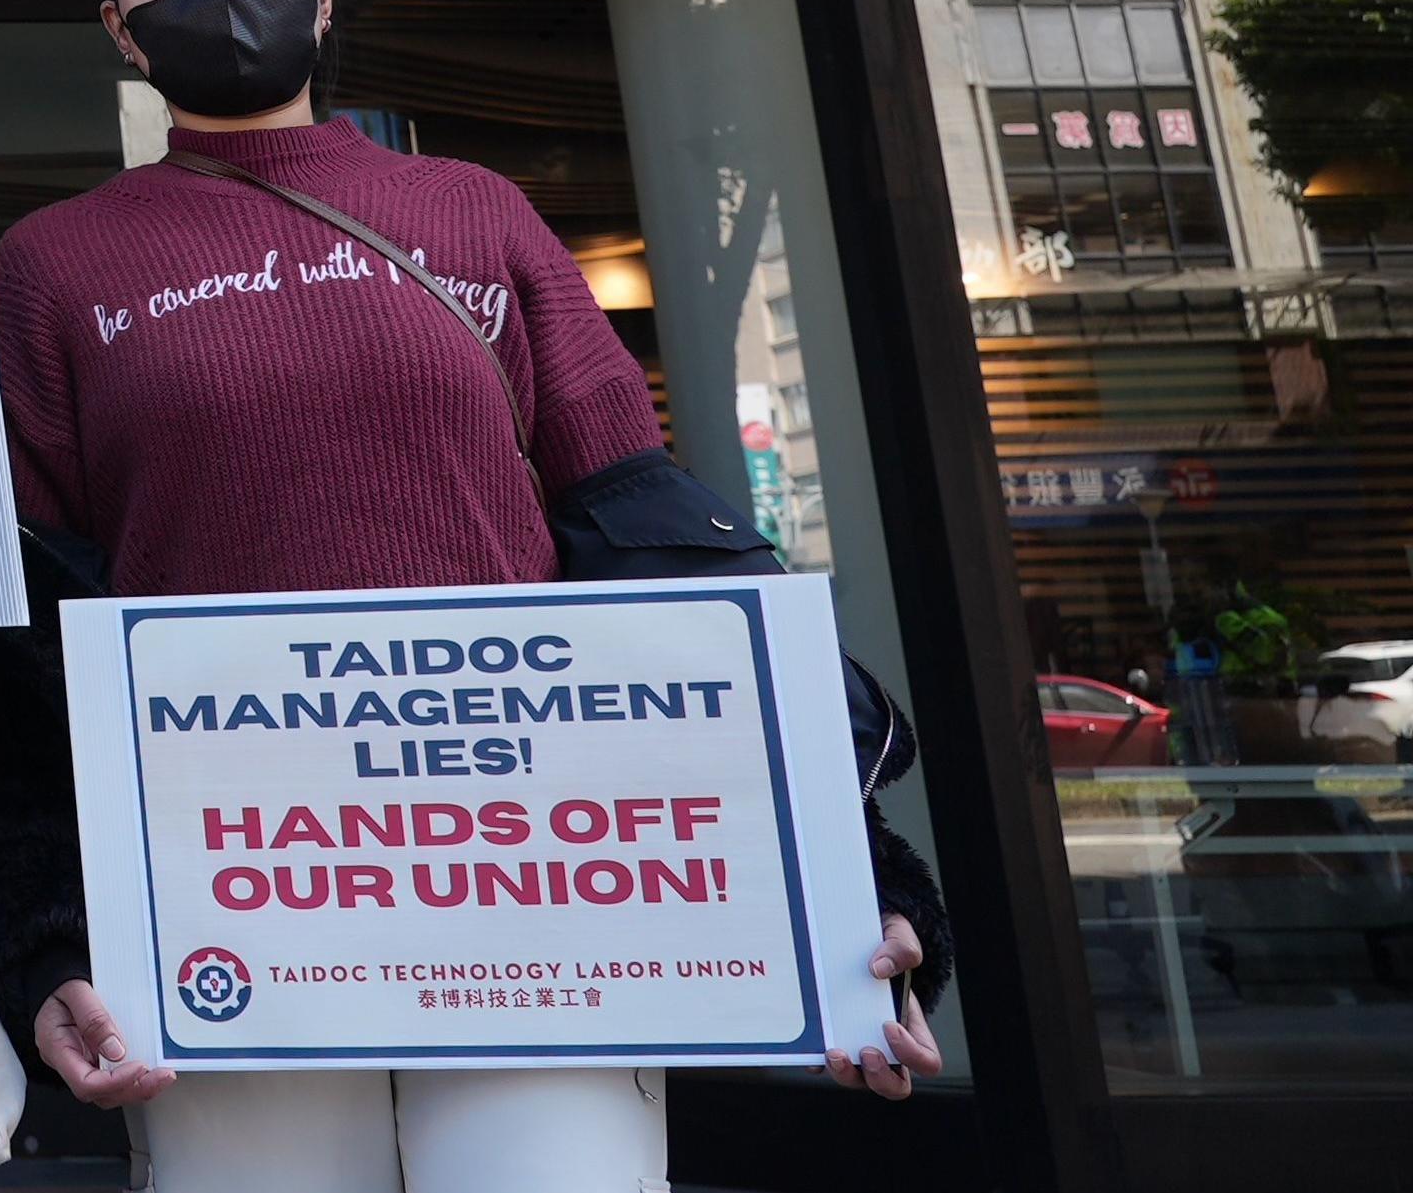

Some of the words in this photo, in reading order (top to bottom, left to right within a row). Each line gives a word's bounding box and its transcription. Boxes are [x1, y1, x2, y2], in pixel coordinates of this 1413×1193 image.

[94, 304, 133, 345] be
[149, 250, 282, 318] covered
[299, 241, 374, 284] with
[288, 634, 573, 679] TAIDOC
[148, 680, 733, 733] MANAGEMENT
[353, 737, 533, 778] LIES!
[202, 800, 531, 851] HANDS
[549, 796, 723, 844] OFF
[211, 864, 397, 911] OUR
[411, 857, 729, 908] UNION!
[268, 965, 368, 983] TAIDOC
[379, 962, 562, 982] TECHNOLOGY
[575, 961, 664, 979] LABOR
[675, 958, 767, 978] UNION
[416, 986, 603, 1009] 泰博科技企業工會
